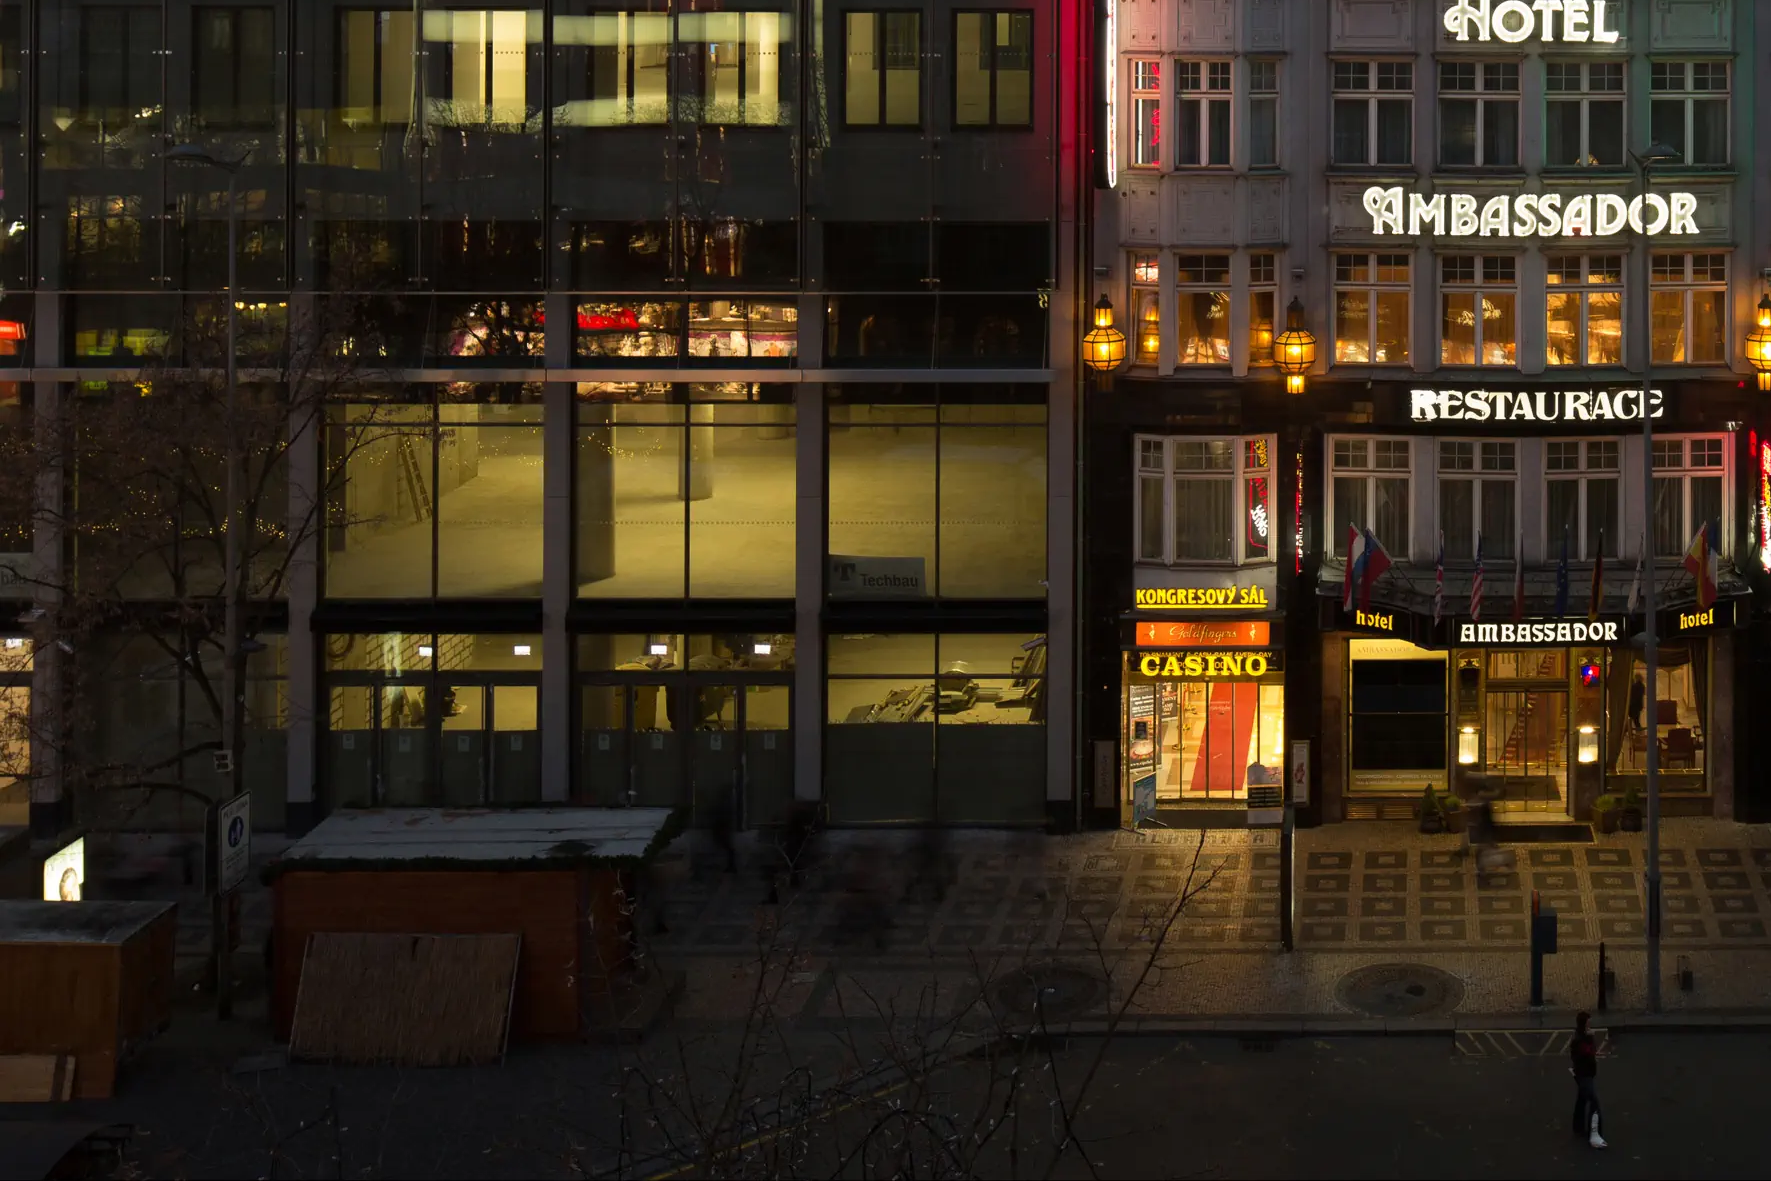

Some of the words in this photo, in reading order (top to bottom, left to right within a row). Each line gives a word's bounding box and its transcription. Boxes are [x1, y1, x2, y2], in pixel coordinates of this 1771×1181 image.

[1363, 186, 1700, 236] AMBASSADOR
[1411, 389, 1664, 421] RESTAURACE
[860, 573, 918, 587] Techbau
[1136, 584, 1237, 604] KONGRESOVÝ
[1241, 585, 1268, 603] SÁL
[1356, 609, 1393, 631] hotel
[1680, 609, 1714, 630] hotel
[1169, 624, 1238, 643] Goldfingers
[1460, 621, 1618, 643] AMBASSADOR
[1141, 655, 1267, 676] CASINO
